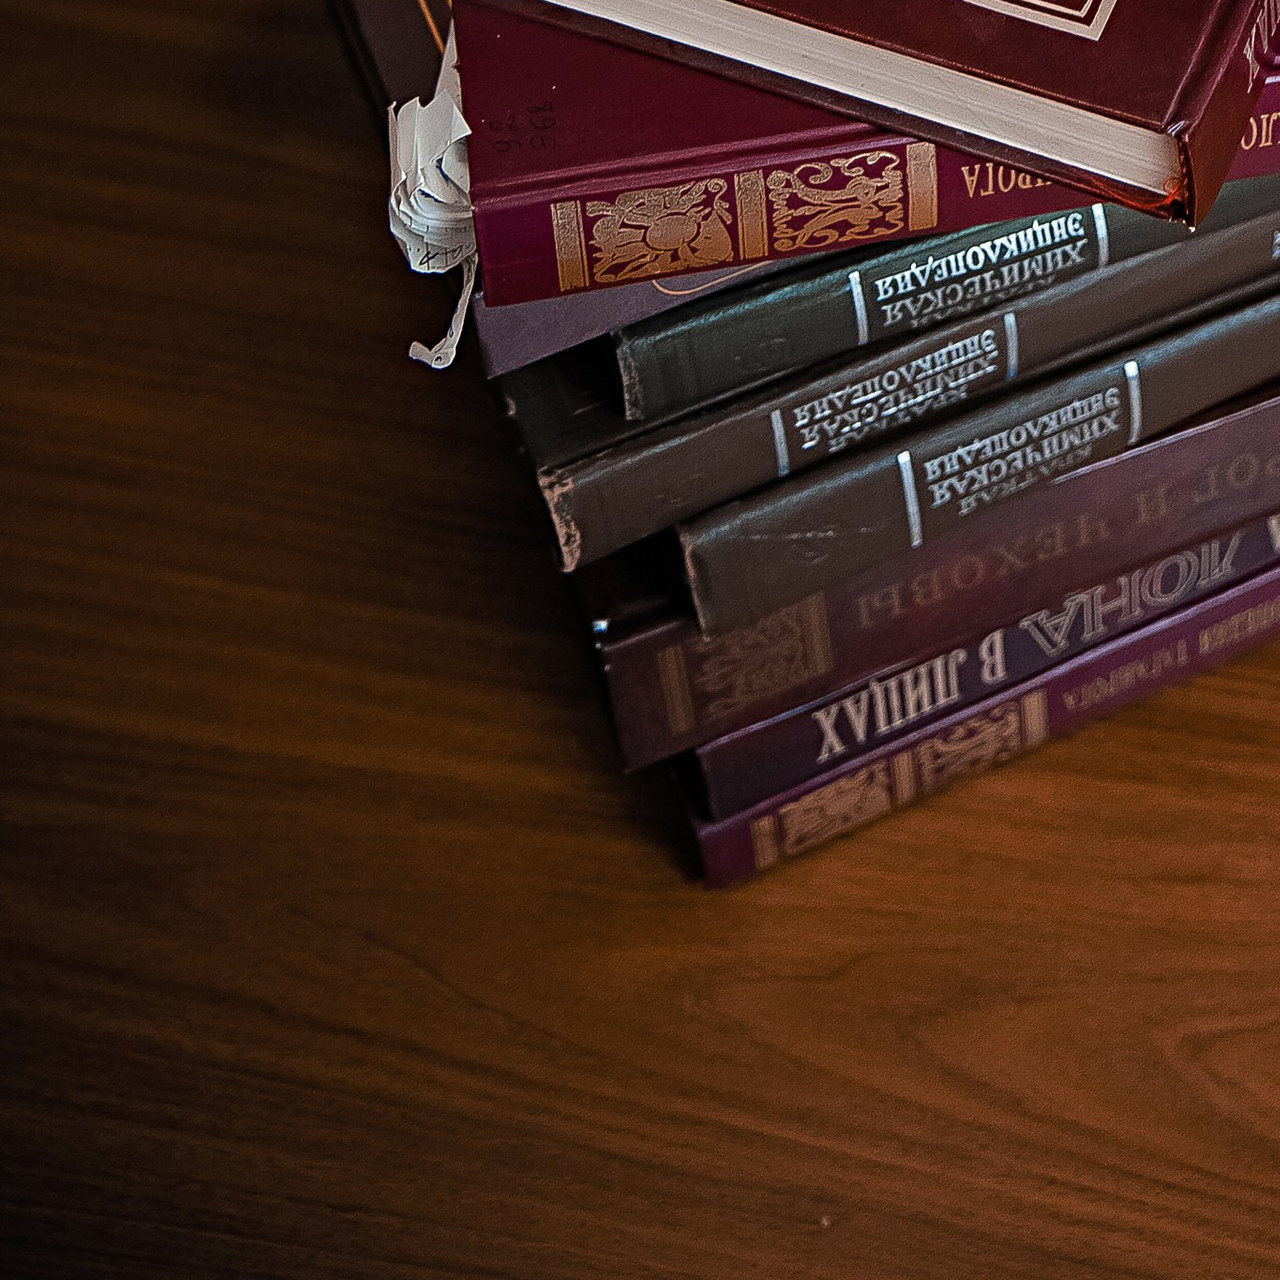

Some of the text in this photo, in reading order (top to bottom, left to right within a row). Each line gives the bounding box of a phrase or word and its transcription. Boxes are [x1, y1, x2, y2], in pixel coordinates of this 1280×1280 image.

[961, 162, 1053, 198] РОГА
[875, 212, 1084, 302] ЭНЦИКЛОПЕДИЯ
[881, 239, 1087, 327] ХИМИЧЕСКАЯ
[794, 329, 996, 427] ЭНЦИКЛОПЕДИЯ
[800, 351, 999, 450] ХИМИЧЕСКАЯ
[924, 387, 1119, 482] ЭНЦИКЛОПЕДИЯ
[928, 410, 1120, 509] ХИМИЧЕСКАЯ
[978, 627, 1006, 686] В
[811, 648, 968, 764] ЛИЦАХ
